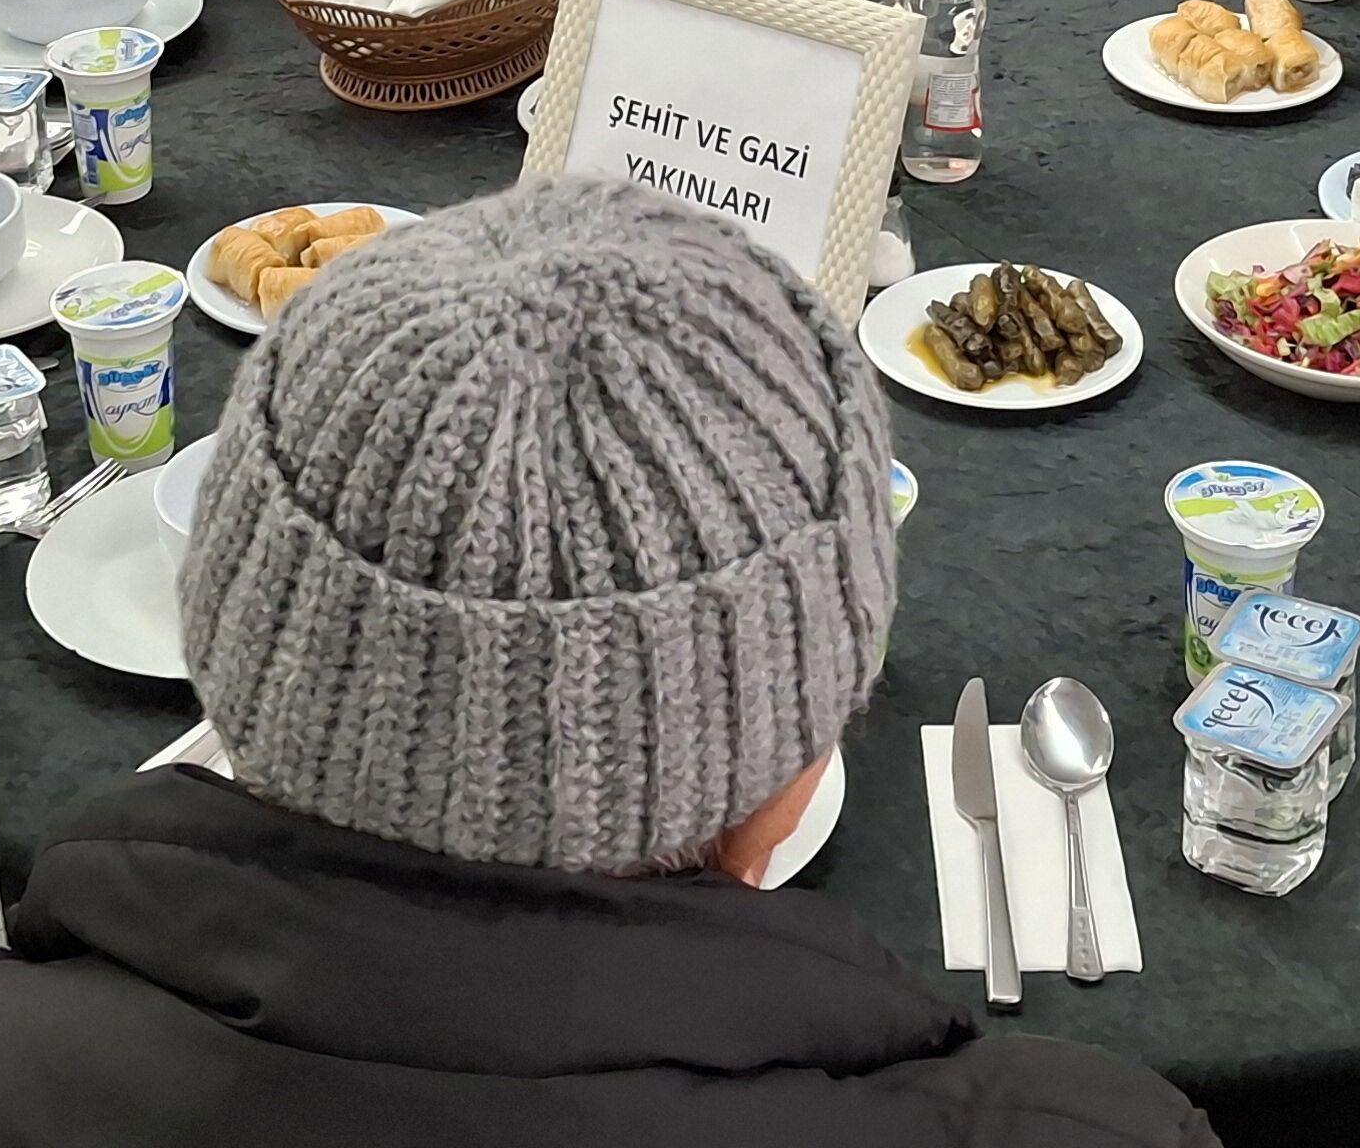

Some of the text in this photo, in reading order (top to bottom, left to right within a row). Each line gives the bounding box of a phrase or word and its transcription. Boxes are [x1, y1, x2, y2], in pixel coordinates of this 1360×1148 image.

[608, 95, 811, 179] ŞEHİT VE GAZİ
[625, 152, 772, 224] YAKINLARI
